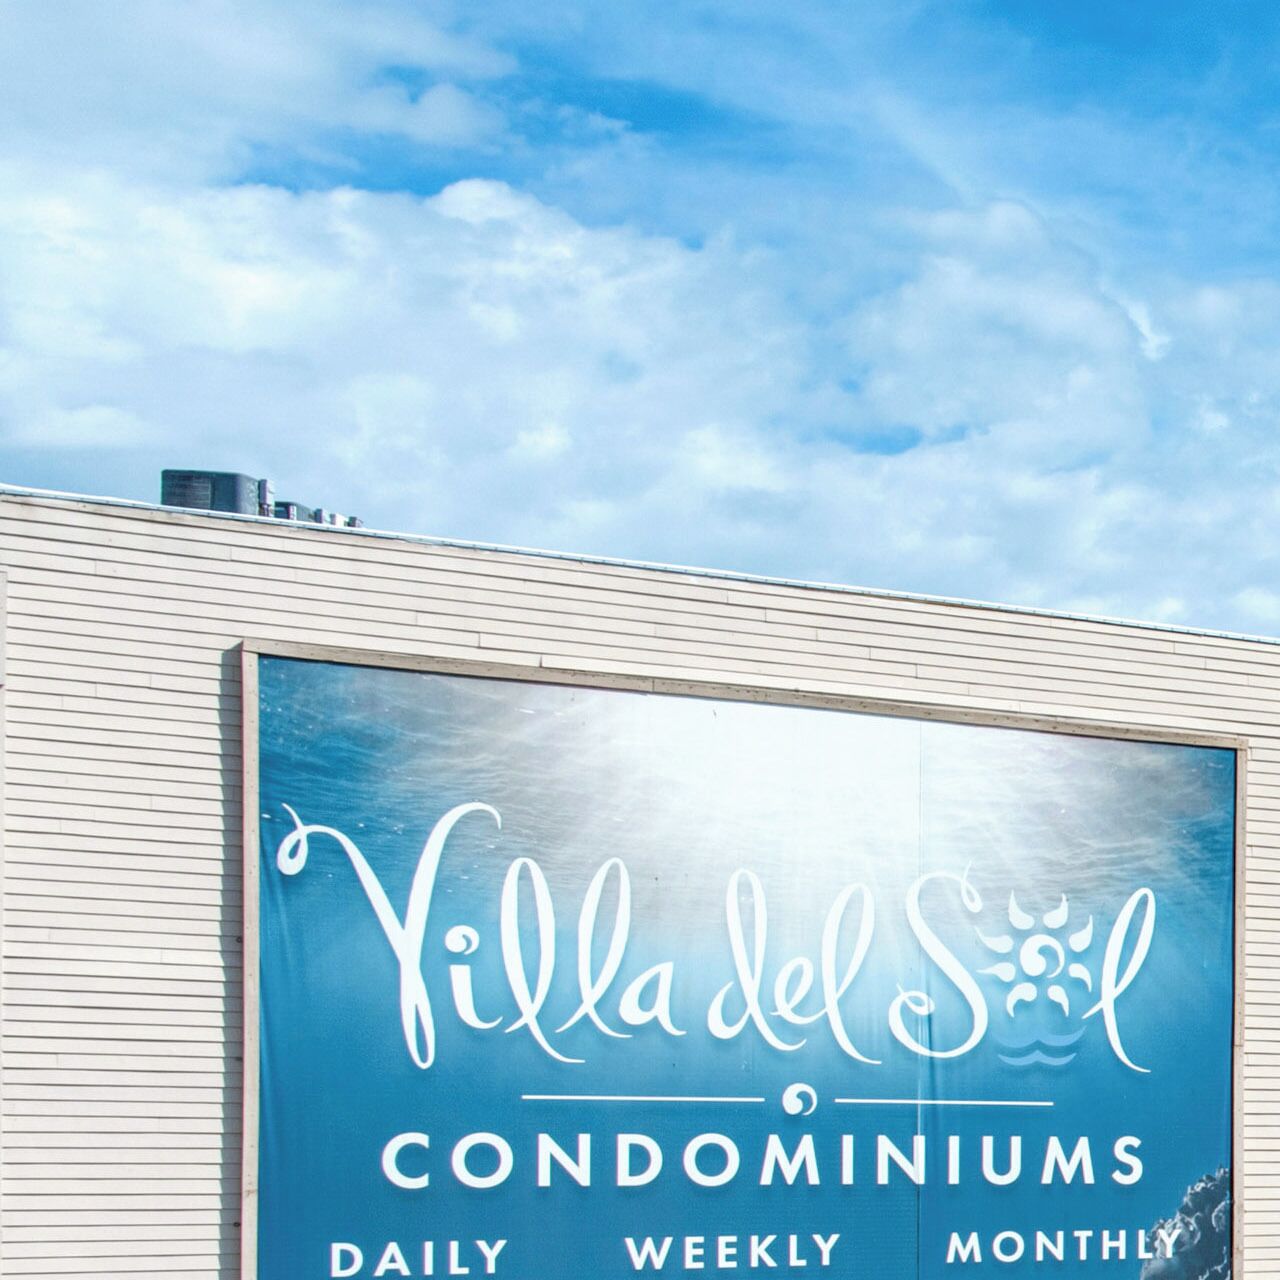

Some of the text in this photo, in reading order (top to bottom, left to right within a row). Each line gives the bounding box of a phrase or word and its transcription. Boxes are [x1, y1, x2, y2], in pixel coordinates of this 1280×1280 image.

[276, 802, 687, 1070] Villa
[708, 868, 883, 1064] del
[381, 1132, 1144, 1189] CONDOMINIUMS
[330, 1229, 1182, 1277] DAILY WEEKLY MONTHLY
